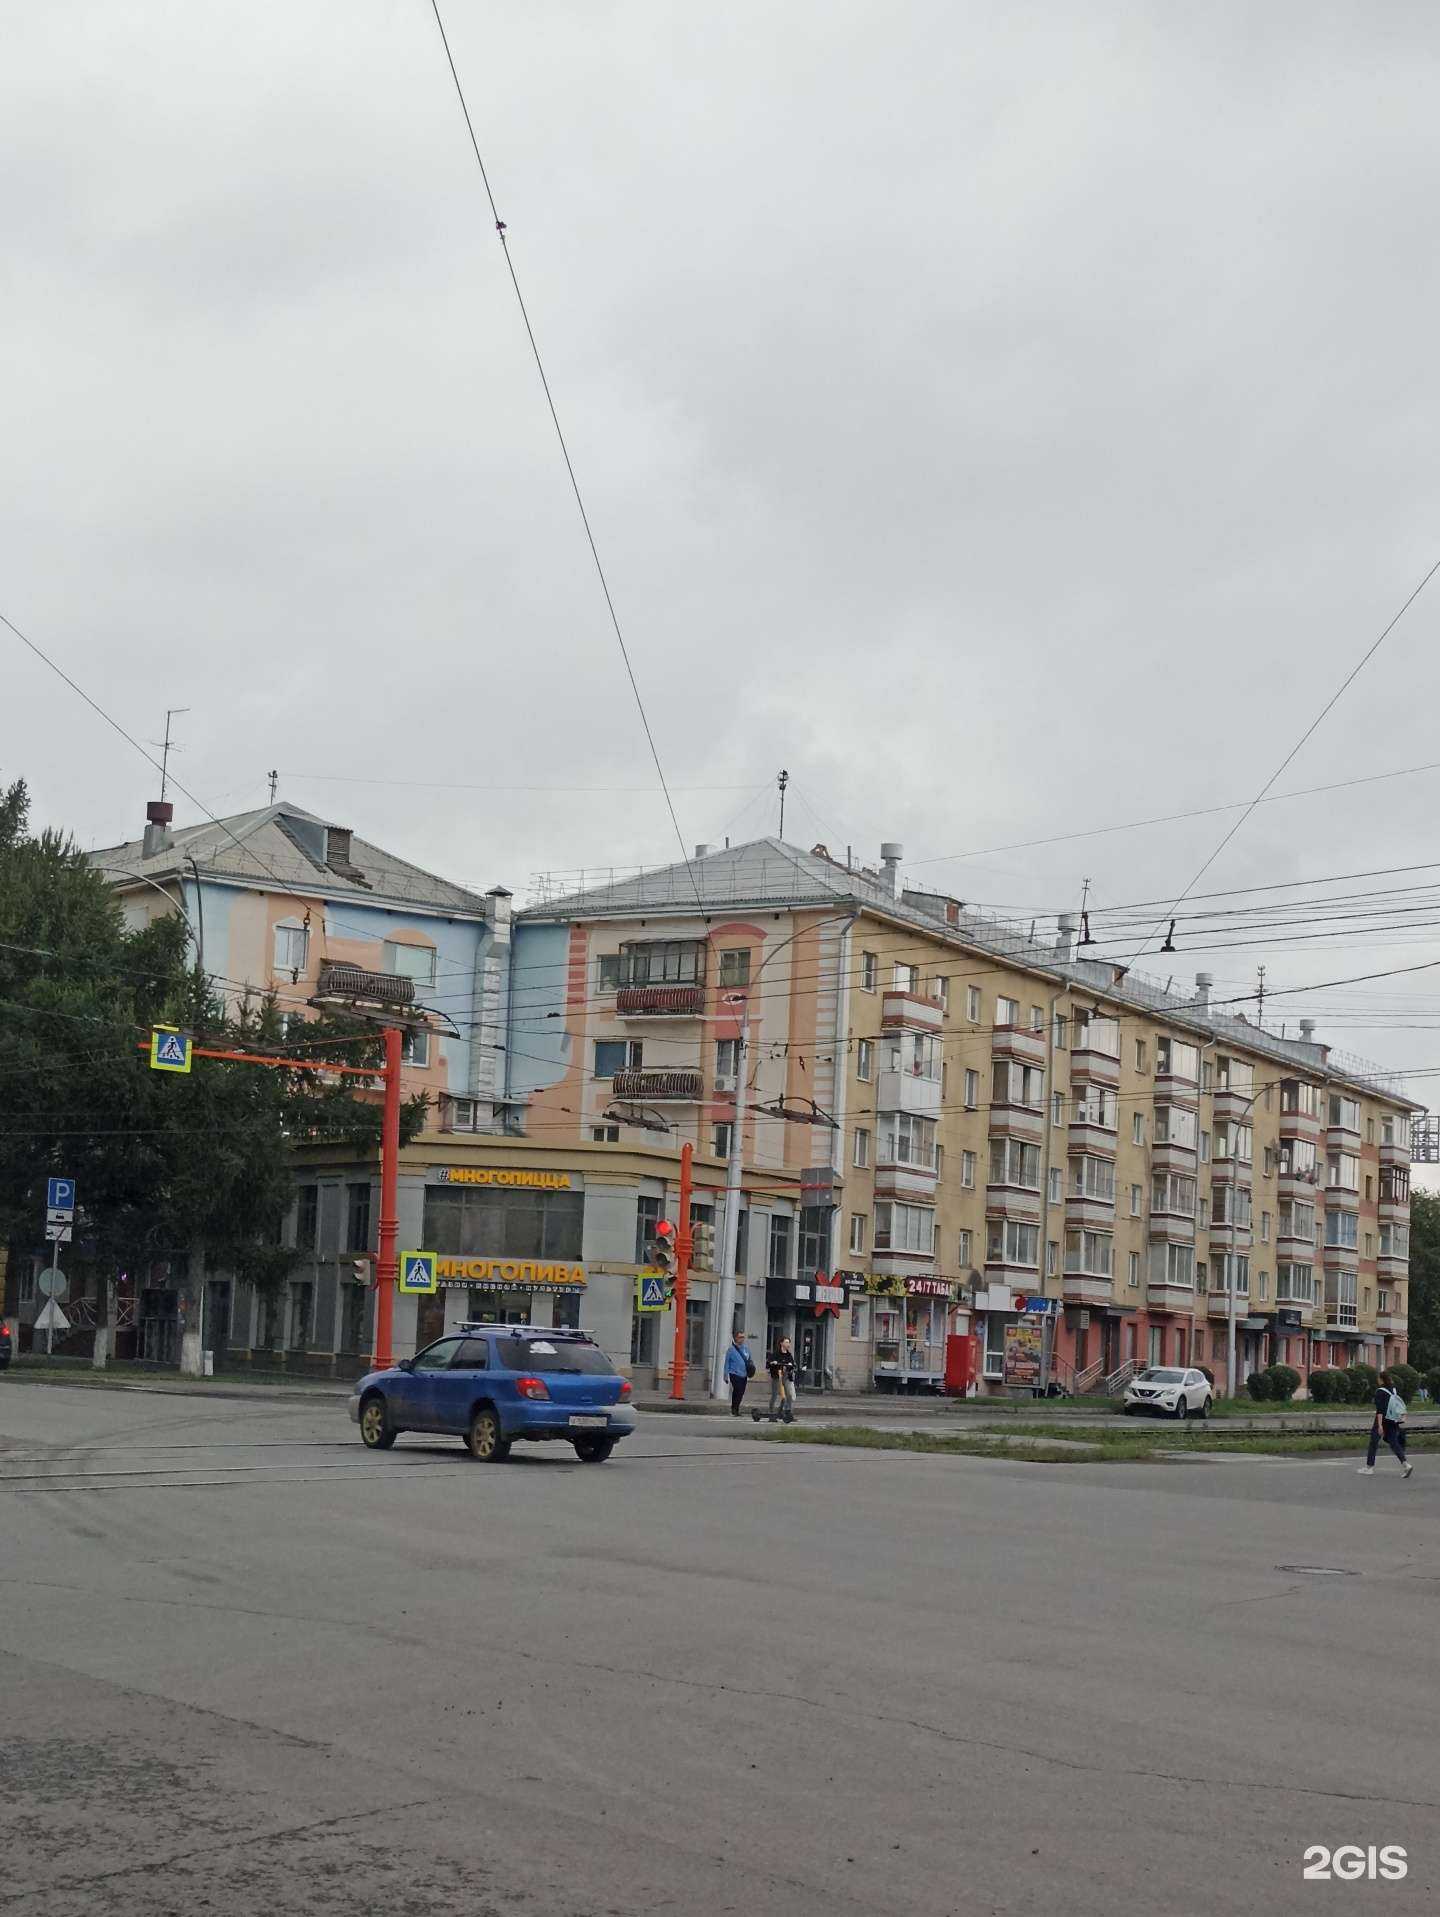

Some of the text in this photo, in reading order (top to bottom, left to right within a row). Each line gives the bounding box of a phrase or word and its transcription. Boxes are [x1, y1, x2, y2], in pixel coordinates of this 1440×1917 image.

[440, 1167, 571, 1188] #МНОГОПИЦЦА
[55, 1182, 71, 1205] P
[908, 1279, 931, 1293] 24/7
